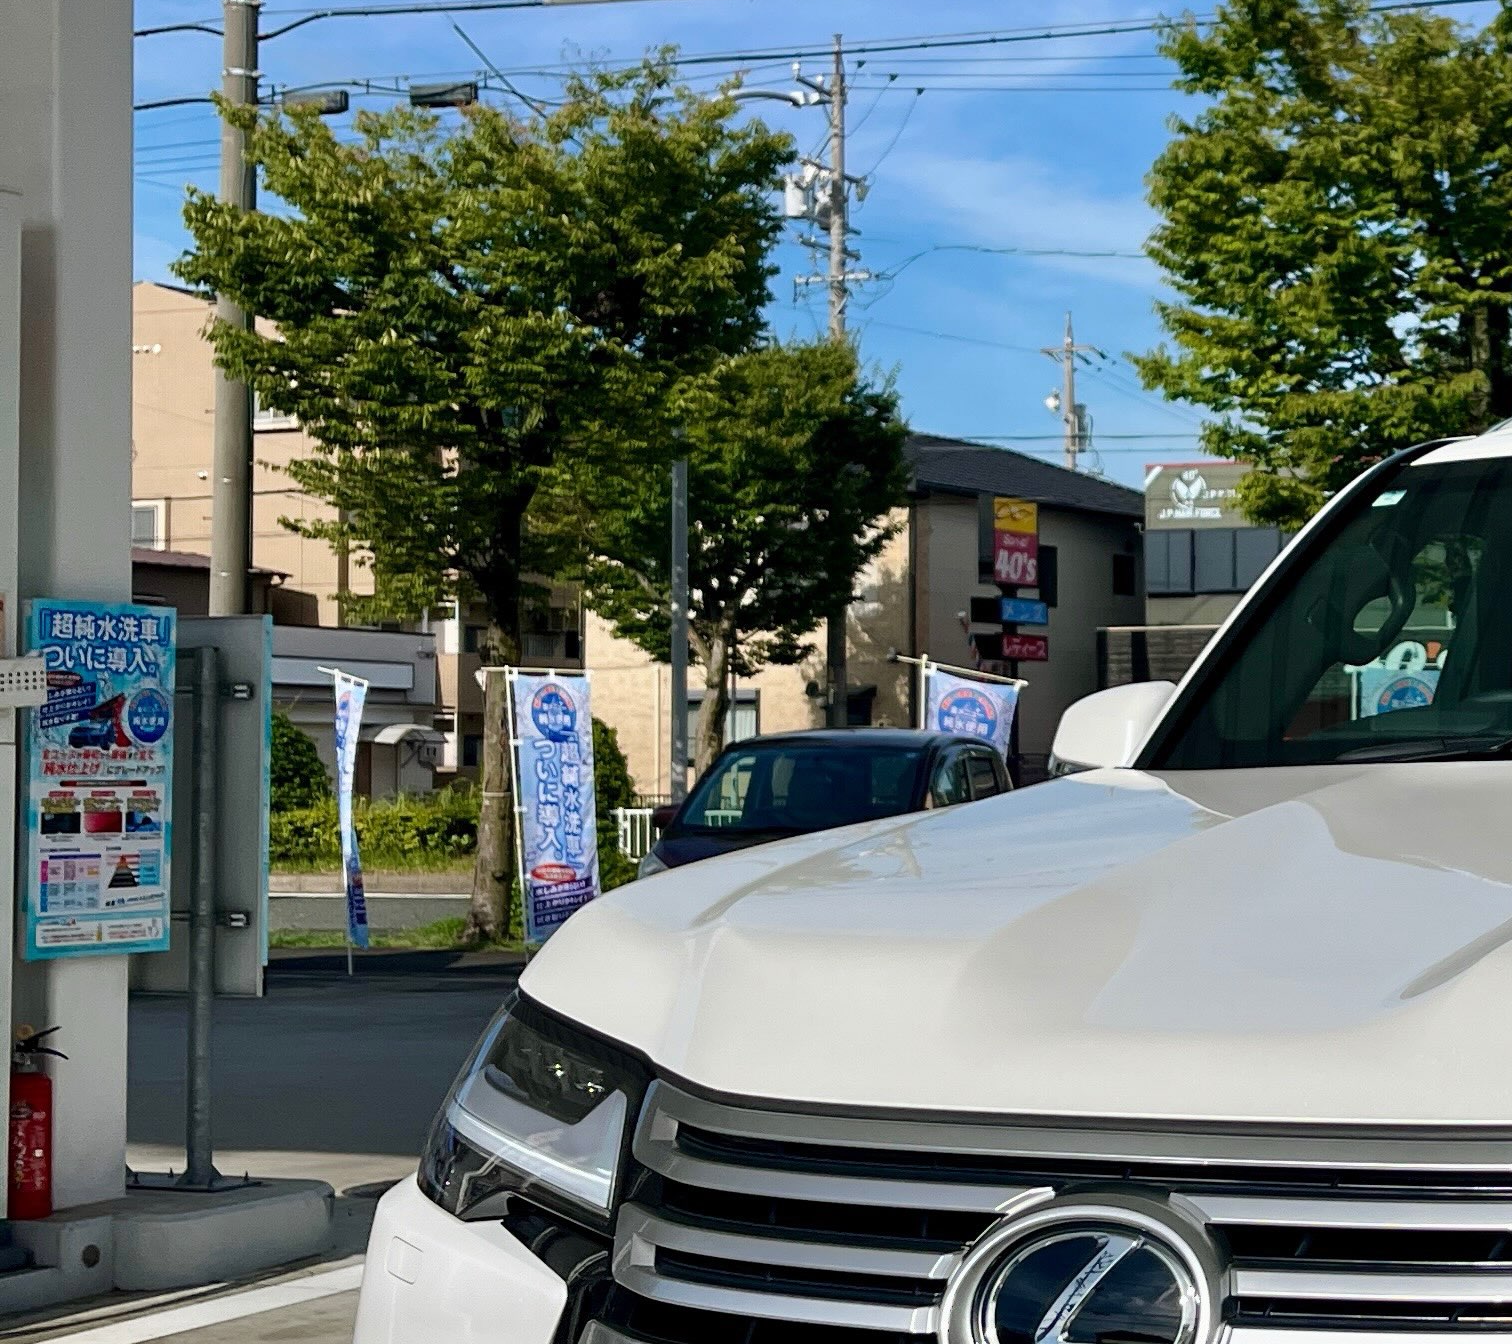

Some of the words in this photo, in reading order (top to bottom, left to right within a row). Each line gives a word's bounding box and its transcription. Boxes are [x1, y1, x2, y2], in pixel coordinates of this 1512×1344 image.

[995, 549, 1037, 581] 40's
[42, 644, 157, 674] ついに導入。
[1003, 638, 1046, 657] レディース
[534, 739, 562, 860] ついに導入。
